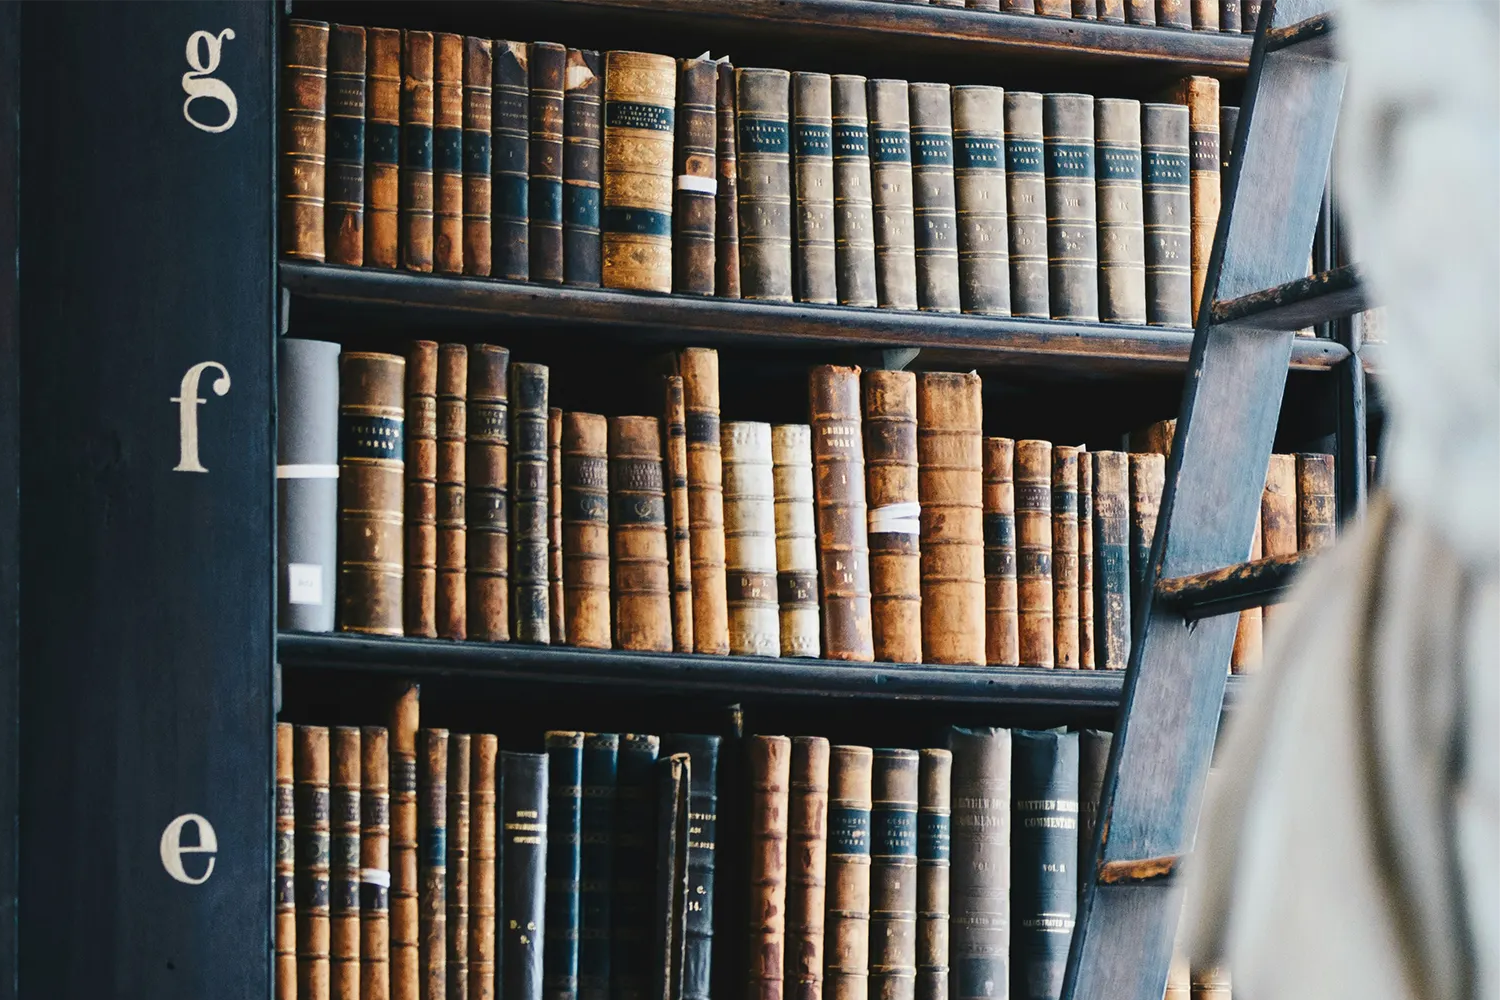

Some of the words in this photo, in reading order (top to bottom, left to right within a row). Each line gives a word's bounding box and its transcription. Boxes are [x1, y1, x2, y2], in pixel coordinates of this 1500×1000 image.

[182, 28, 239, 134] g
[170, 361, 231, 472] f
[827, 439, 855, 447] WORKS
[160, 813, 218, 884] e
